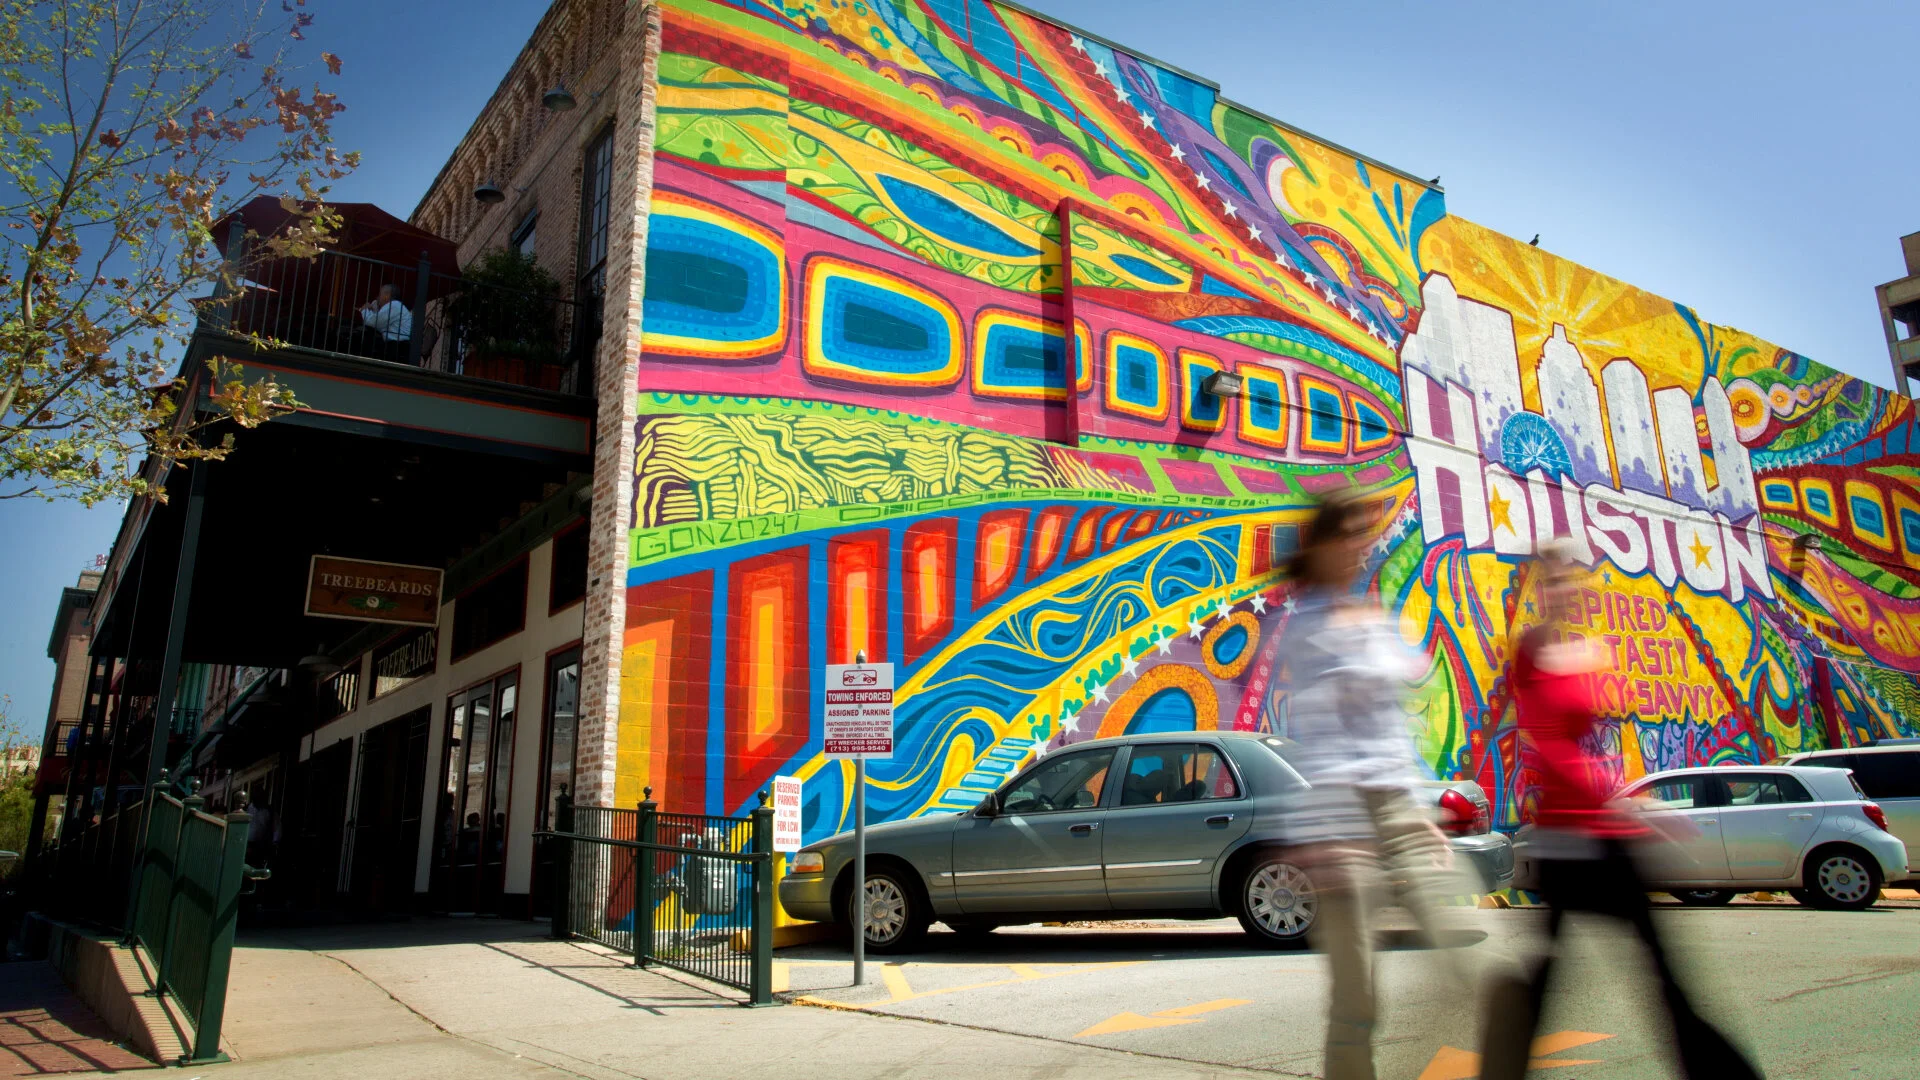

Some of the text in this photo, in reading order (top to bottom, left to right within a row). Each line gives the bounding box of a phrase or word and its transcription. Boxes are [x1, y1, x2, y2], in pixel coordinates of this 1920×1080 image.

[1404, 365, 1775, 602] HOUSTON
[636, 513, 801, 562] GONZO247
[320, 573, 433, 597] TREEBEARDS
[1602, 633, 1689, 679] TASTY
[828, 692, 891, 702] TOWING ENFORCED
[1634, 679, 1715, 719] SAVVY
[828, 709, 860, 717] ASSIGNED
[776, 781, 800, 794] RESERVED
[777, 794, 799, 806] PARKING
[776, 820, 787, 832] FOR
